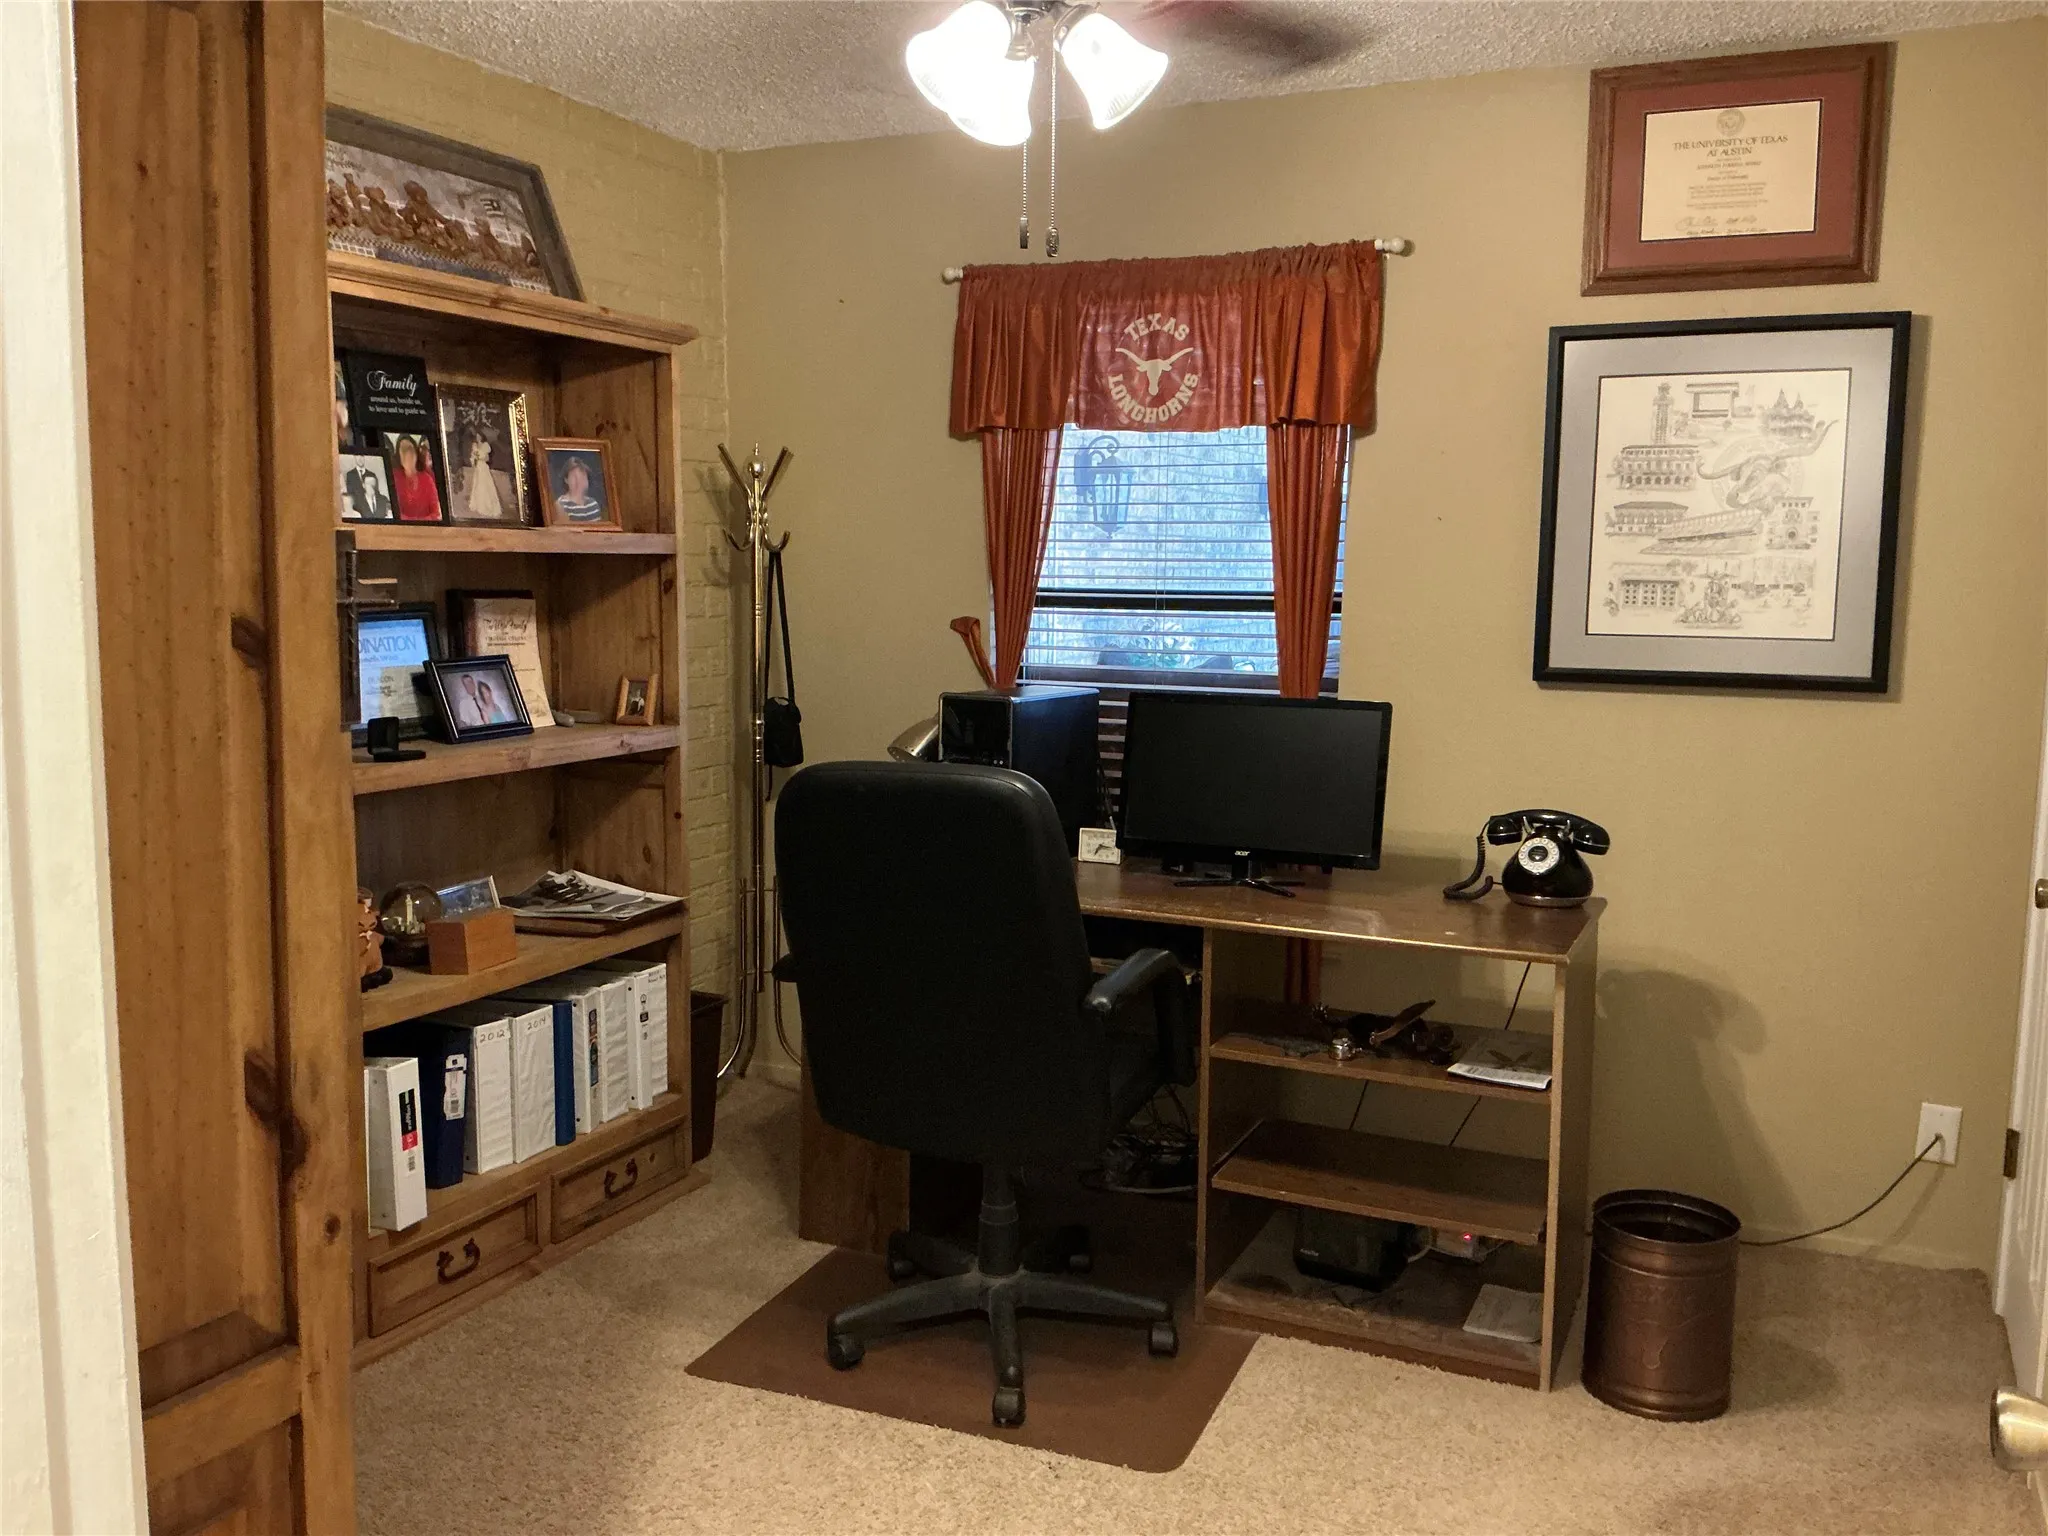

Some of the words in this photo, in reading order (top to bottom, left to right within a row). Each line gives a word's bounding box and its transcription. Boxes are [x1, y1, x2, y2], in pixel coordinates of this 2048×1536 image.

[1673, 142, 1690, 151] THE
[1692, 137, 1745, 149] UNIVERSITY
[1745, 137, 1758, 146] OF
[1760, 135, 1789, 145] TEXAS
[1707, 149, 1718, 157] AT
[1720, 147, 1753, 156] AUSTIN
[1124, 313, 1190, 342] TEXAS
[366, 370, 417, 397] Family
[1107, 373, 1199, 423] LONGHORNS
[527, 1015, 546, 1031] 2014
[480, 1029, 505, 1044] 2012
